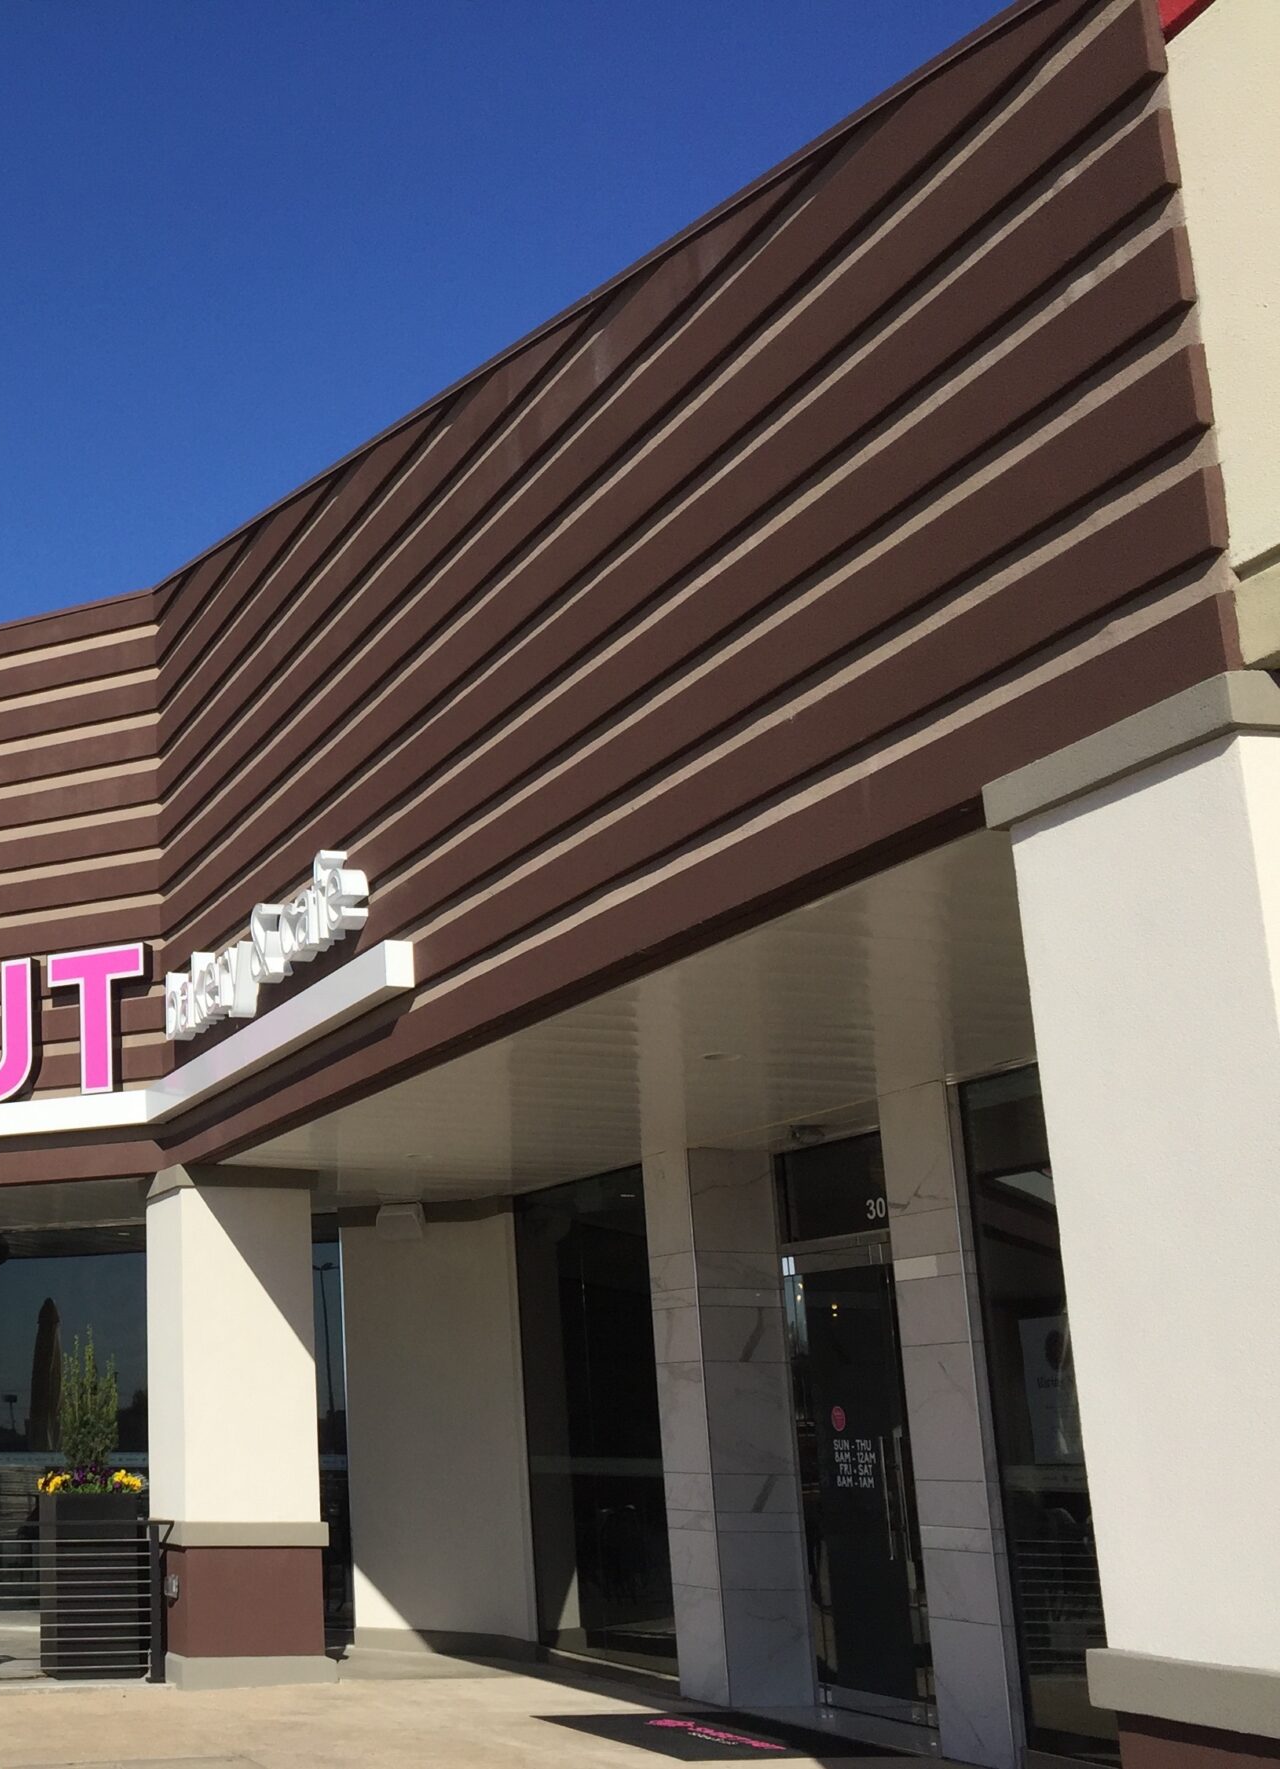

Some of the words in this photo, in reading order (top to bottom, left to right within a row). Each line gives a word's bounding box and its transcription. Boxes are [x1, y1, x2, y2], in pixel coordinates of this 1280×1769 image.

[833, 1439, 850, 1451] SUN
[855, 1439, 872, 1451] THU
[834, 1452, 851, 1463] 8AM
[856, 1452, 876, 1464] 12AM
[840, 1463, 852, 1475] FRI
[858, 1464, 873, 1476] SAT
[858, 1476, 875, 1489] 1AM
